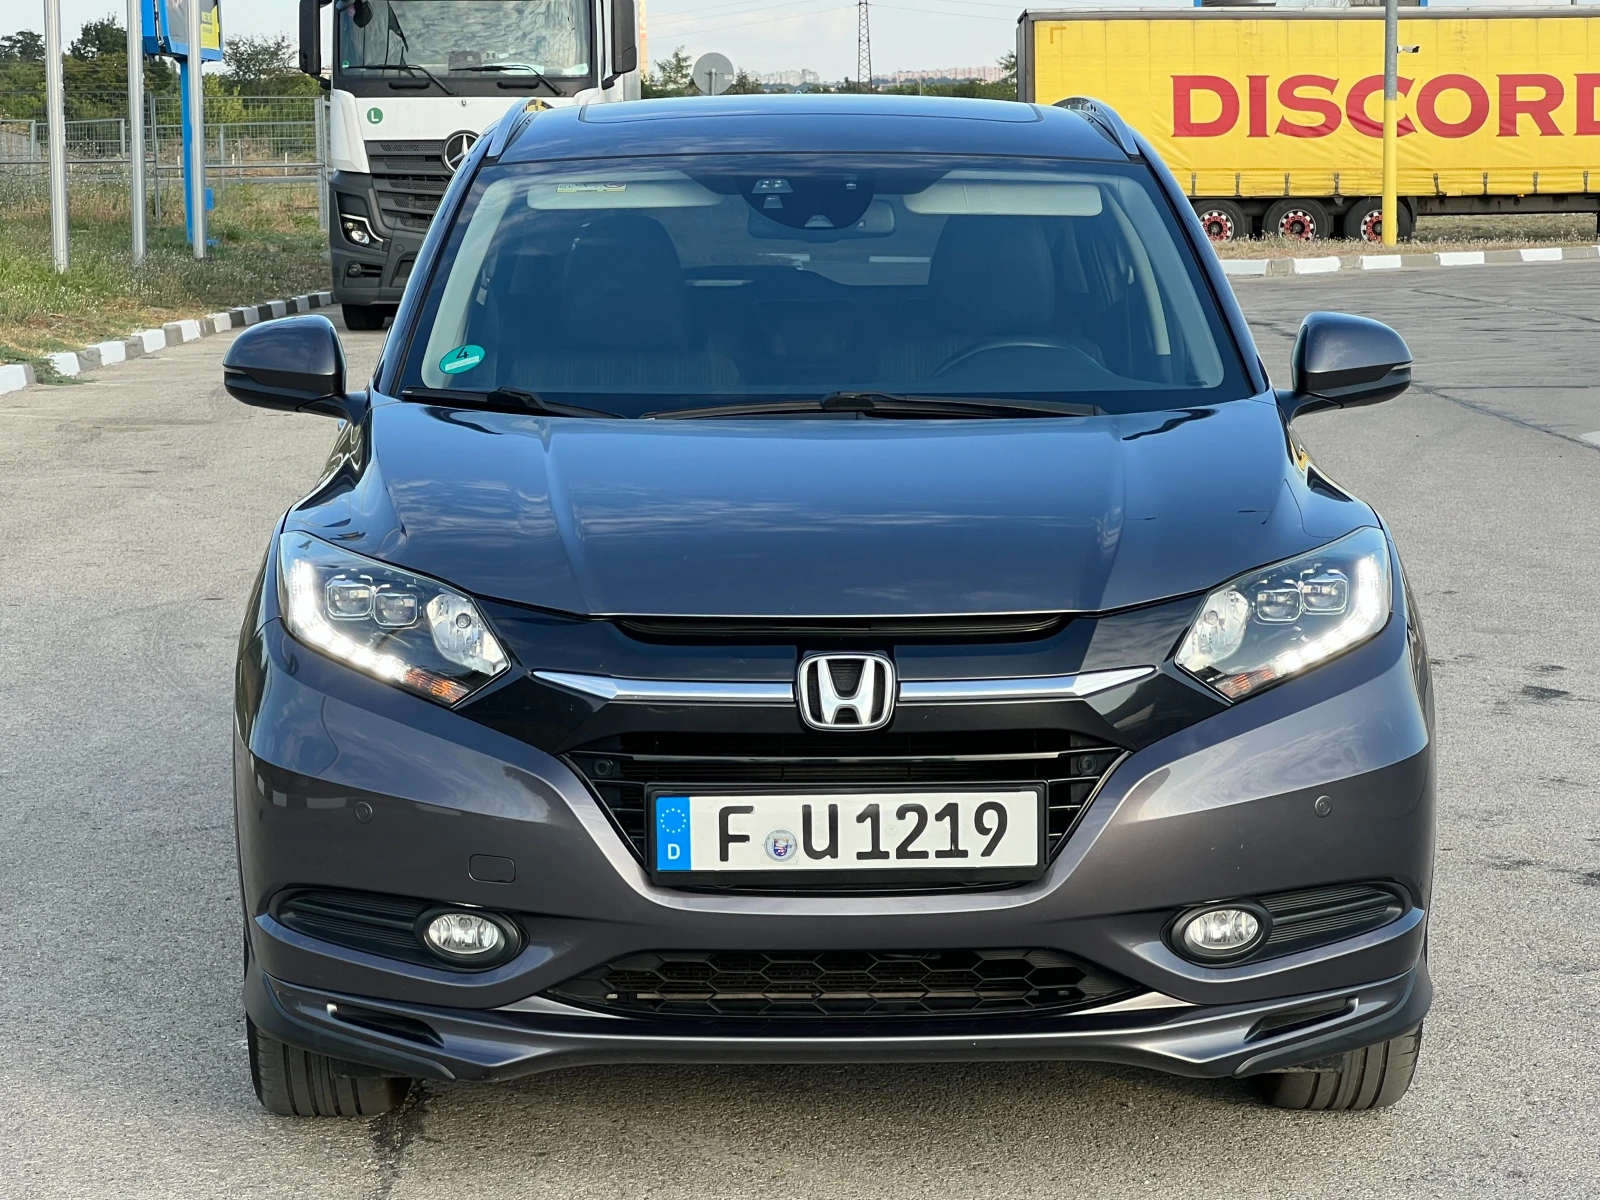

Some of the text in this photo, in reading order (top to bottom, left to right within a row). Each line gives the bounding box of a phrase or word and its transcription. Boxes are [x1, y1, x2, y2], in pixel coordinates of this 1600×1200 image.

[371, 109, 380, 122] L
[456, 346, 469, 359] 4
[718, 805, 755, 862] F
[668, 843, 681, 860] D
